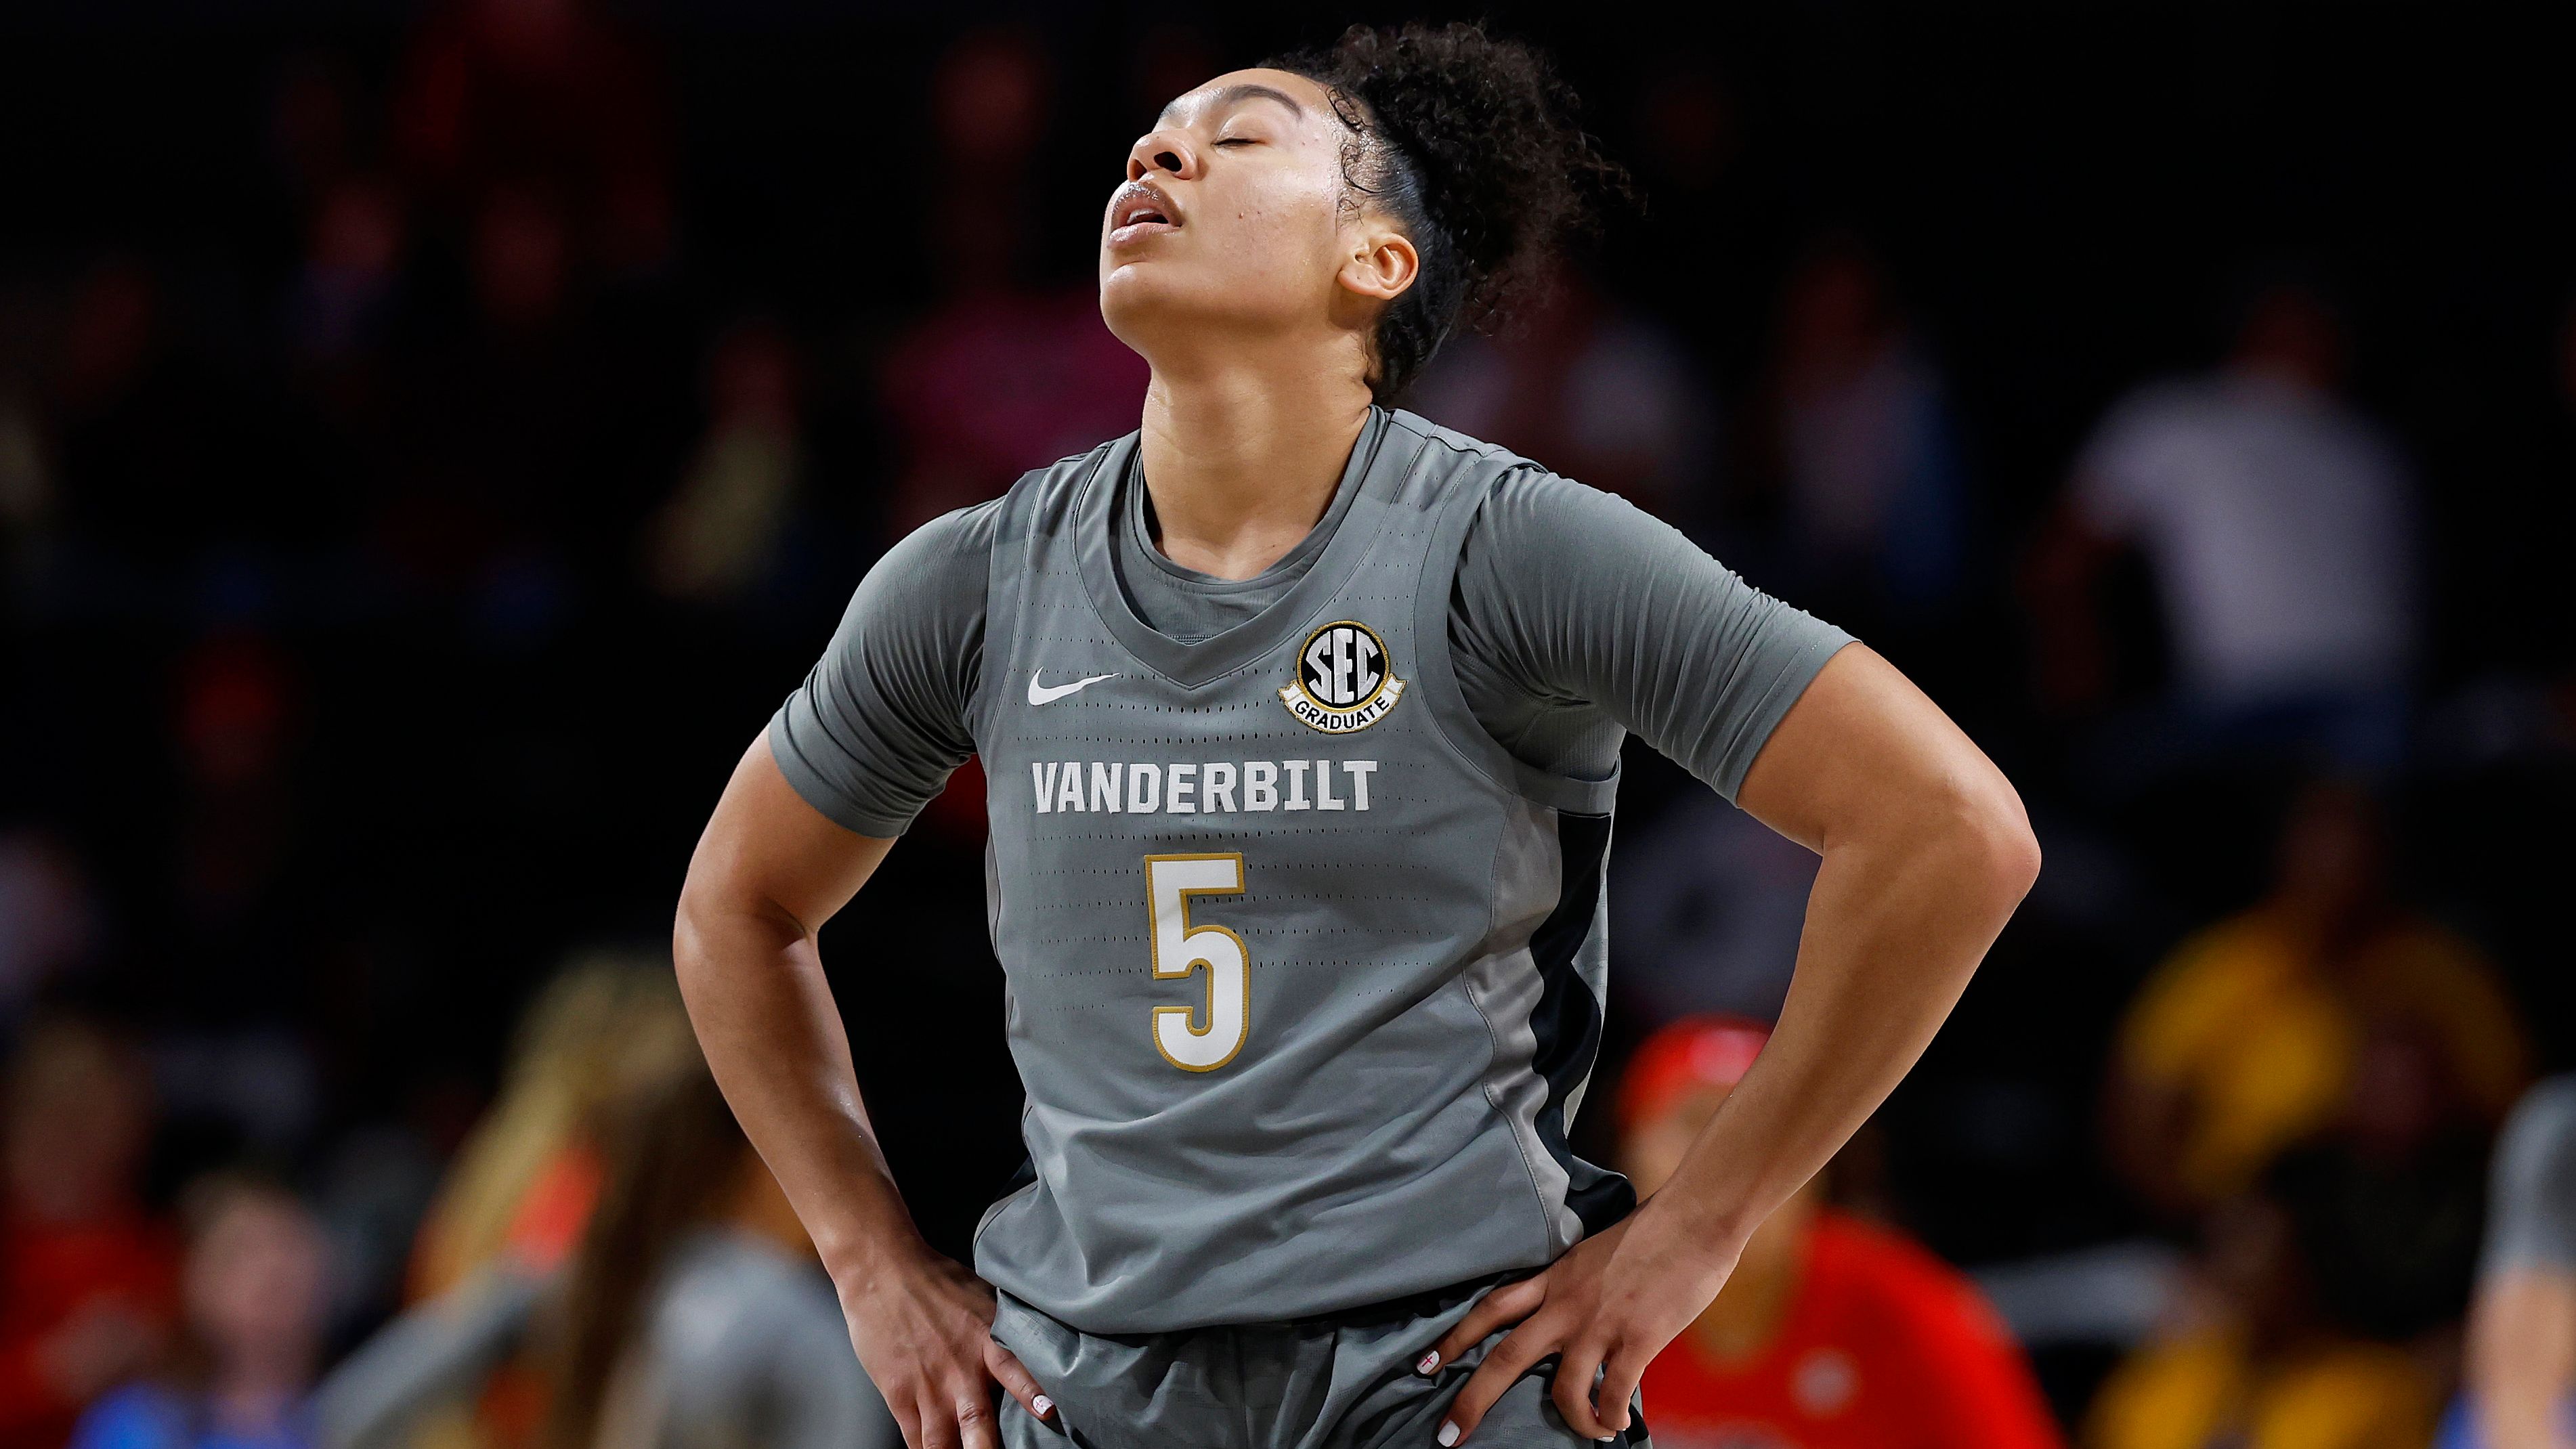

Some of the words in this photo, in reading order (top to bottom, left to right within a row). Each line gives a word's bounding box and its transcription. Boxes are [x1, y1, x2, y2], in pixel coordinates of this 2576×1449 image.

[1306, 628, 1379, 704] SEC
[1295, 696, 1389, 729] GRADUATE
[1032, 760, 1377, 814] VANDERBILT
[1144, 852, 1251, 1073] 5
